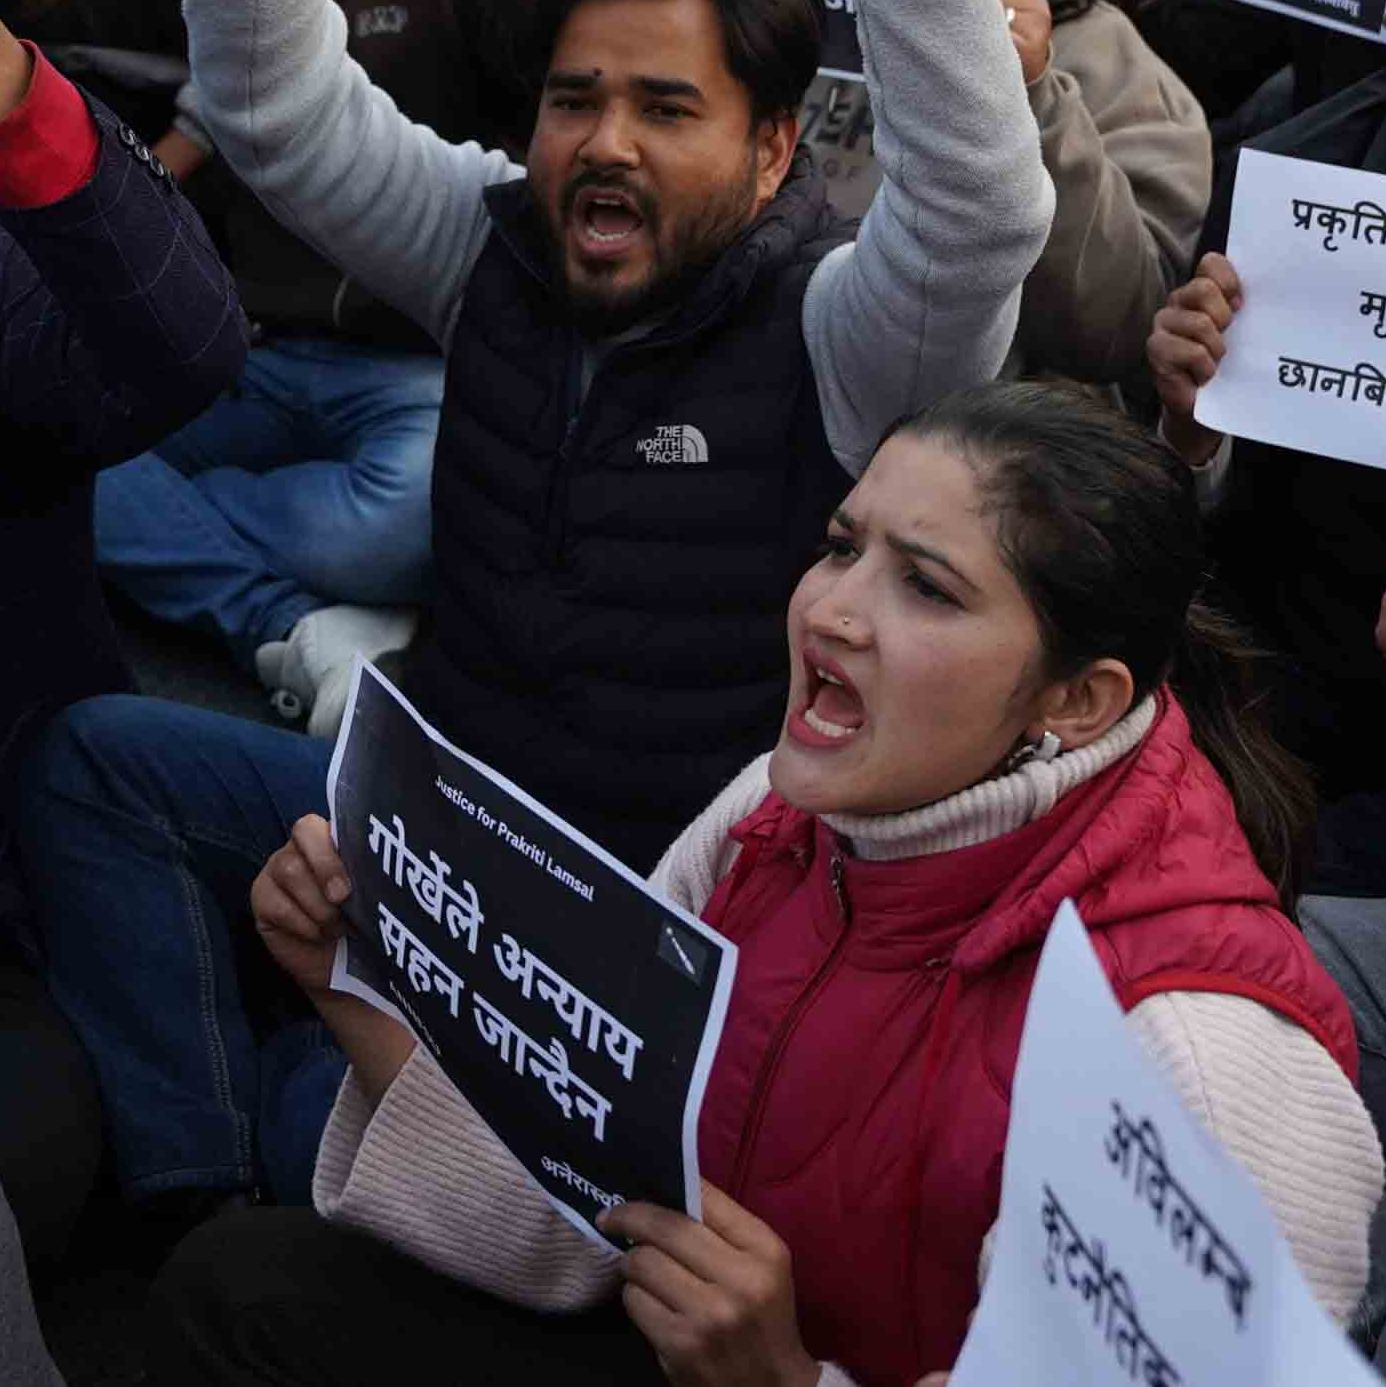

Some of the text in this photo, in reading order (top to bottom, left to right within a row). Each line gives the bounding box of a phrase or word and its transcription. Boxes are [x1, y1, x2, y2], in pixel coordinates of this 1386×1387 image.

[635, 437, 682, 453] NORTH
[645, 450, 682, 463] FACE
[655, 425, 682, 438] THE
[435, 773, 595, 903] Justice for Prakriti Lamsal
[367, 812, 485, 955] गोर्खेले
[492, 932, 644, 1082] अन्याय
[377, 901, 465, 1018] सहन
[472, 990, 614, 1143] जान्दैन
